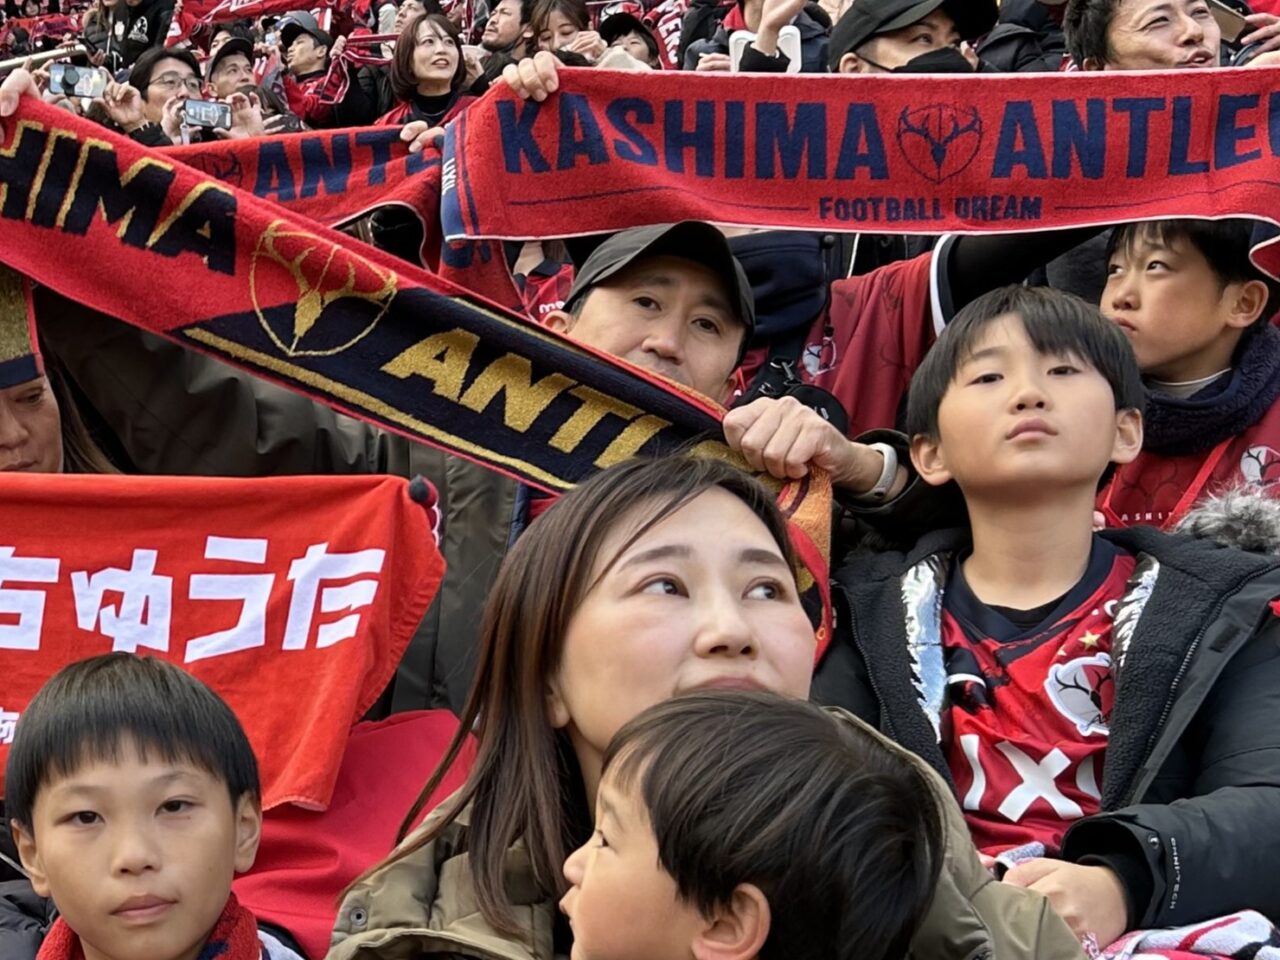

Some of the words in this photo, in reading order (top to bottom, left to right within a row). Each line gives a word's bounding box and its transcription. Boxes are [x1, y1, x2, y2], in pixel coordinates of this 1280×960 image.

[496, 92, 890, 180] KASHIMA
[819, 195, 945, 222] FOOTBALL
[955, 196, 1042, 220] DREAM
